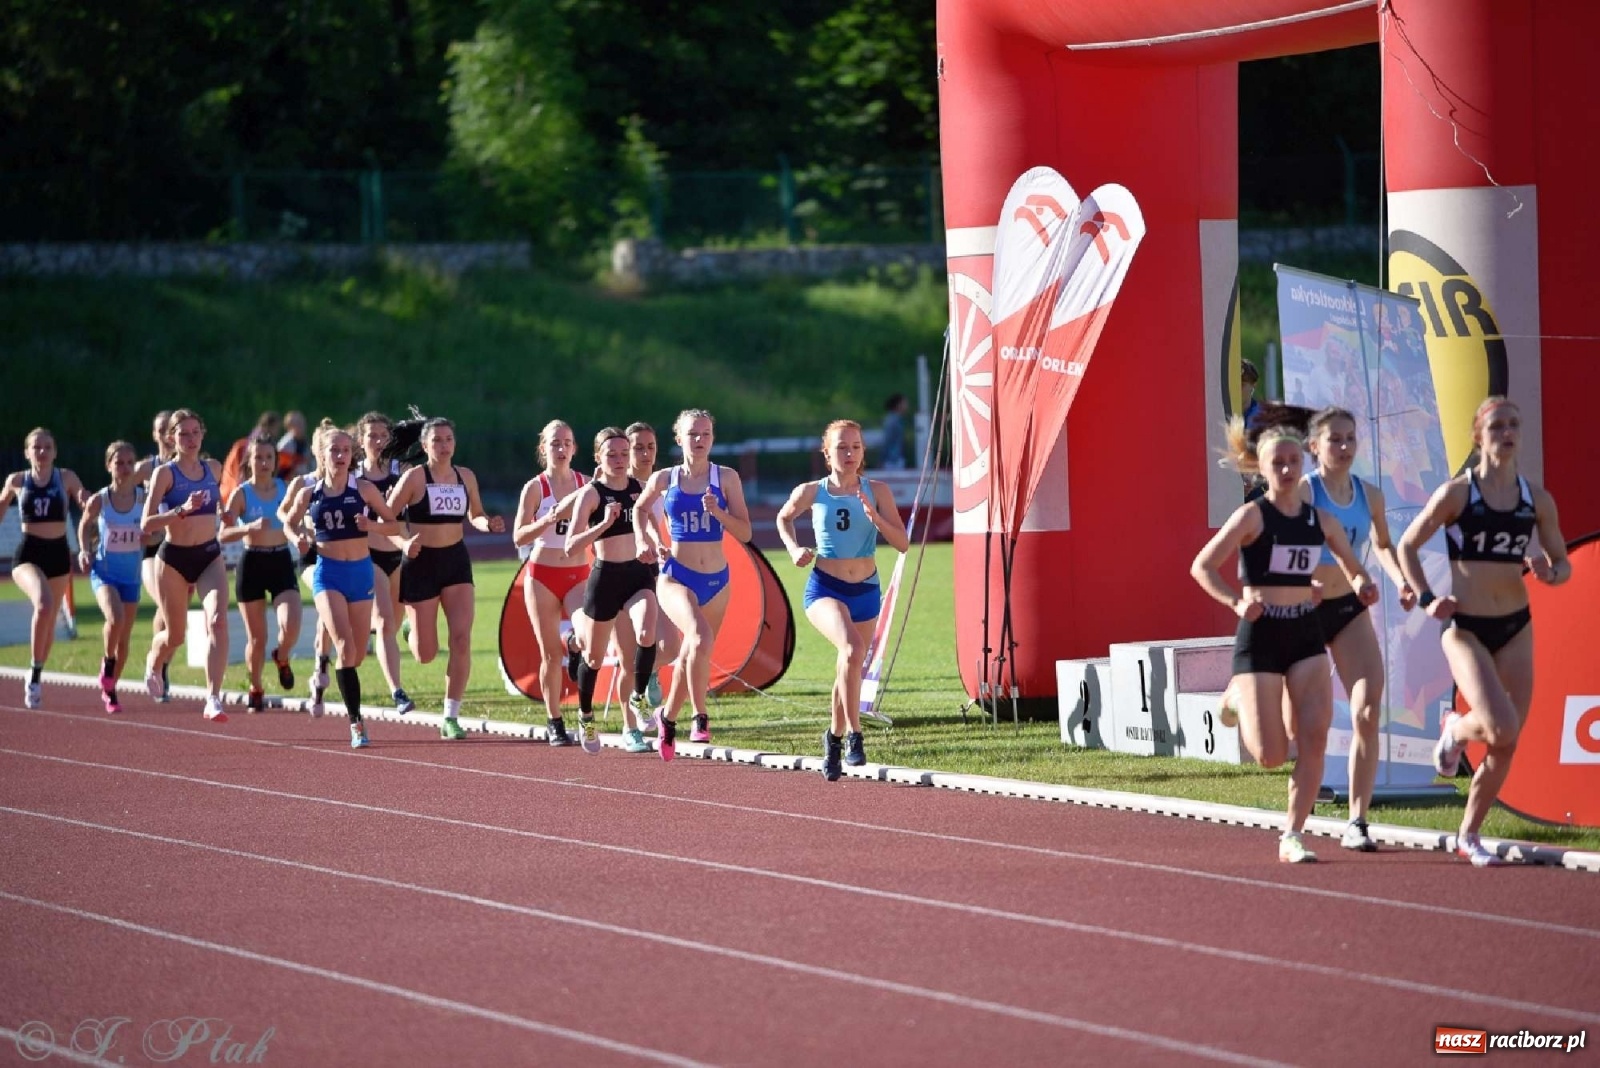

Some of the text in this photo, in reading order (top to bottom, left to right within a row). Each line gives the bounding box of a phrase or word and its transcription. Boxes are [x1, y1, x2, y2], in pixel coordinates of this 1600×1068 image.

[1042, 356, 1085, 376] ORLEN
[33, 498, 50, 517] 37
[434, 496, 462, 511] 203
[323, 510, 346, 530] 32
[681, 511, 711, 533] 154
[836, 508, 850, 532] 3
[110, 531, 135, 544] 241
[1472, 531, 1529, 556] 122
[1287, 548, 1309, 571] 76
[1264, 603, 1299, 619] NIKE
[1138, 660, 1149, 712] 1
[1203, 710, 1215, 755] 3
